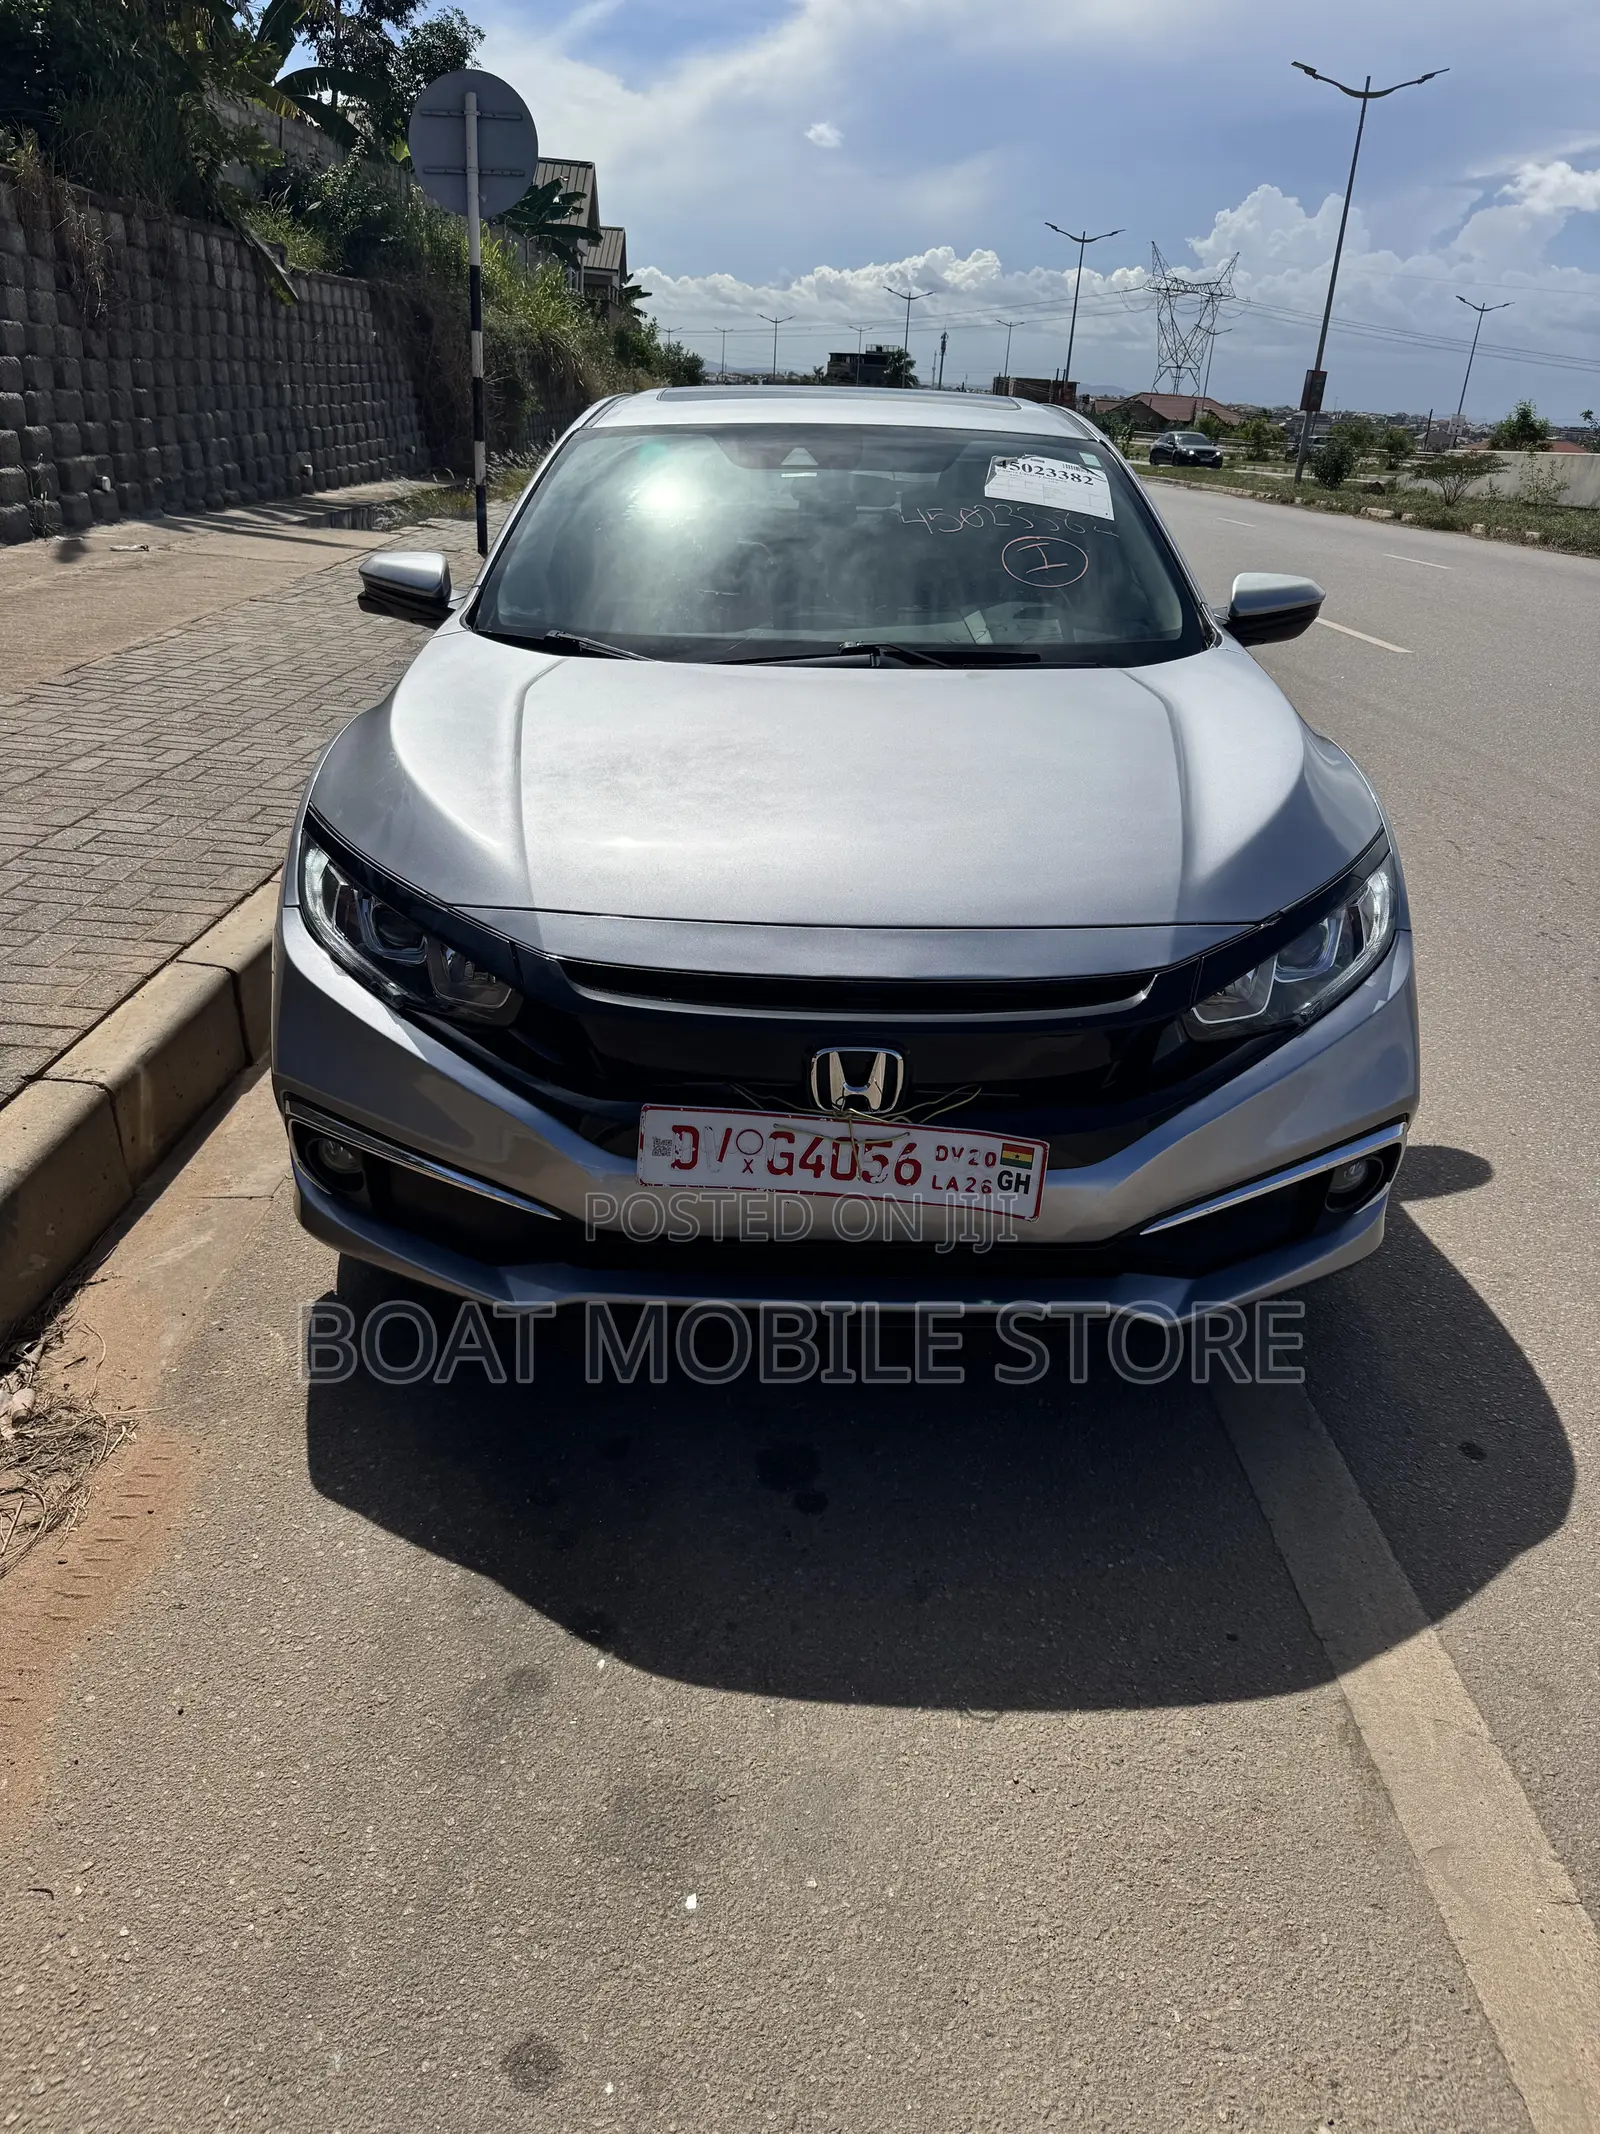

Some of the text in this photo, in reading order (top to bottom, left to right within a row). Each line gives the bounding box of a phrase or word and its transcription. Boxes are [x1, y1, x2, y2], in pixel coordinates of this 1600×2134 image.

[997, 460, 1094, 486] 45023382
[671, 1125, 733, 1173] DV
[766, 1131, 922, 1186] G4056
[935, 1145, 997, 1168] DV20
[931, 1174, 993, 1194] LA26
[997, 1170, 1031, 1194] GH
